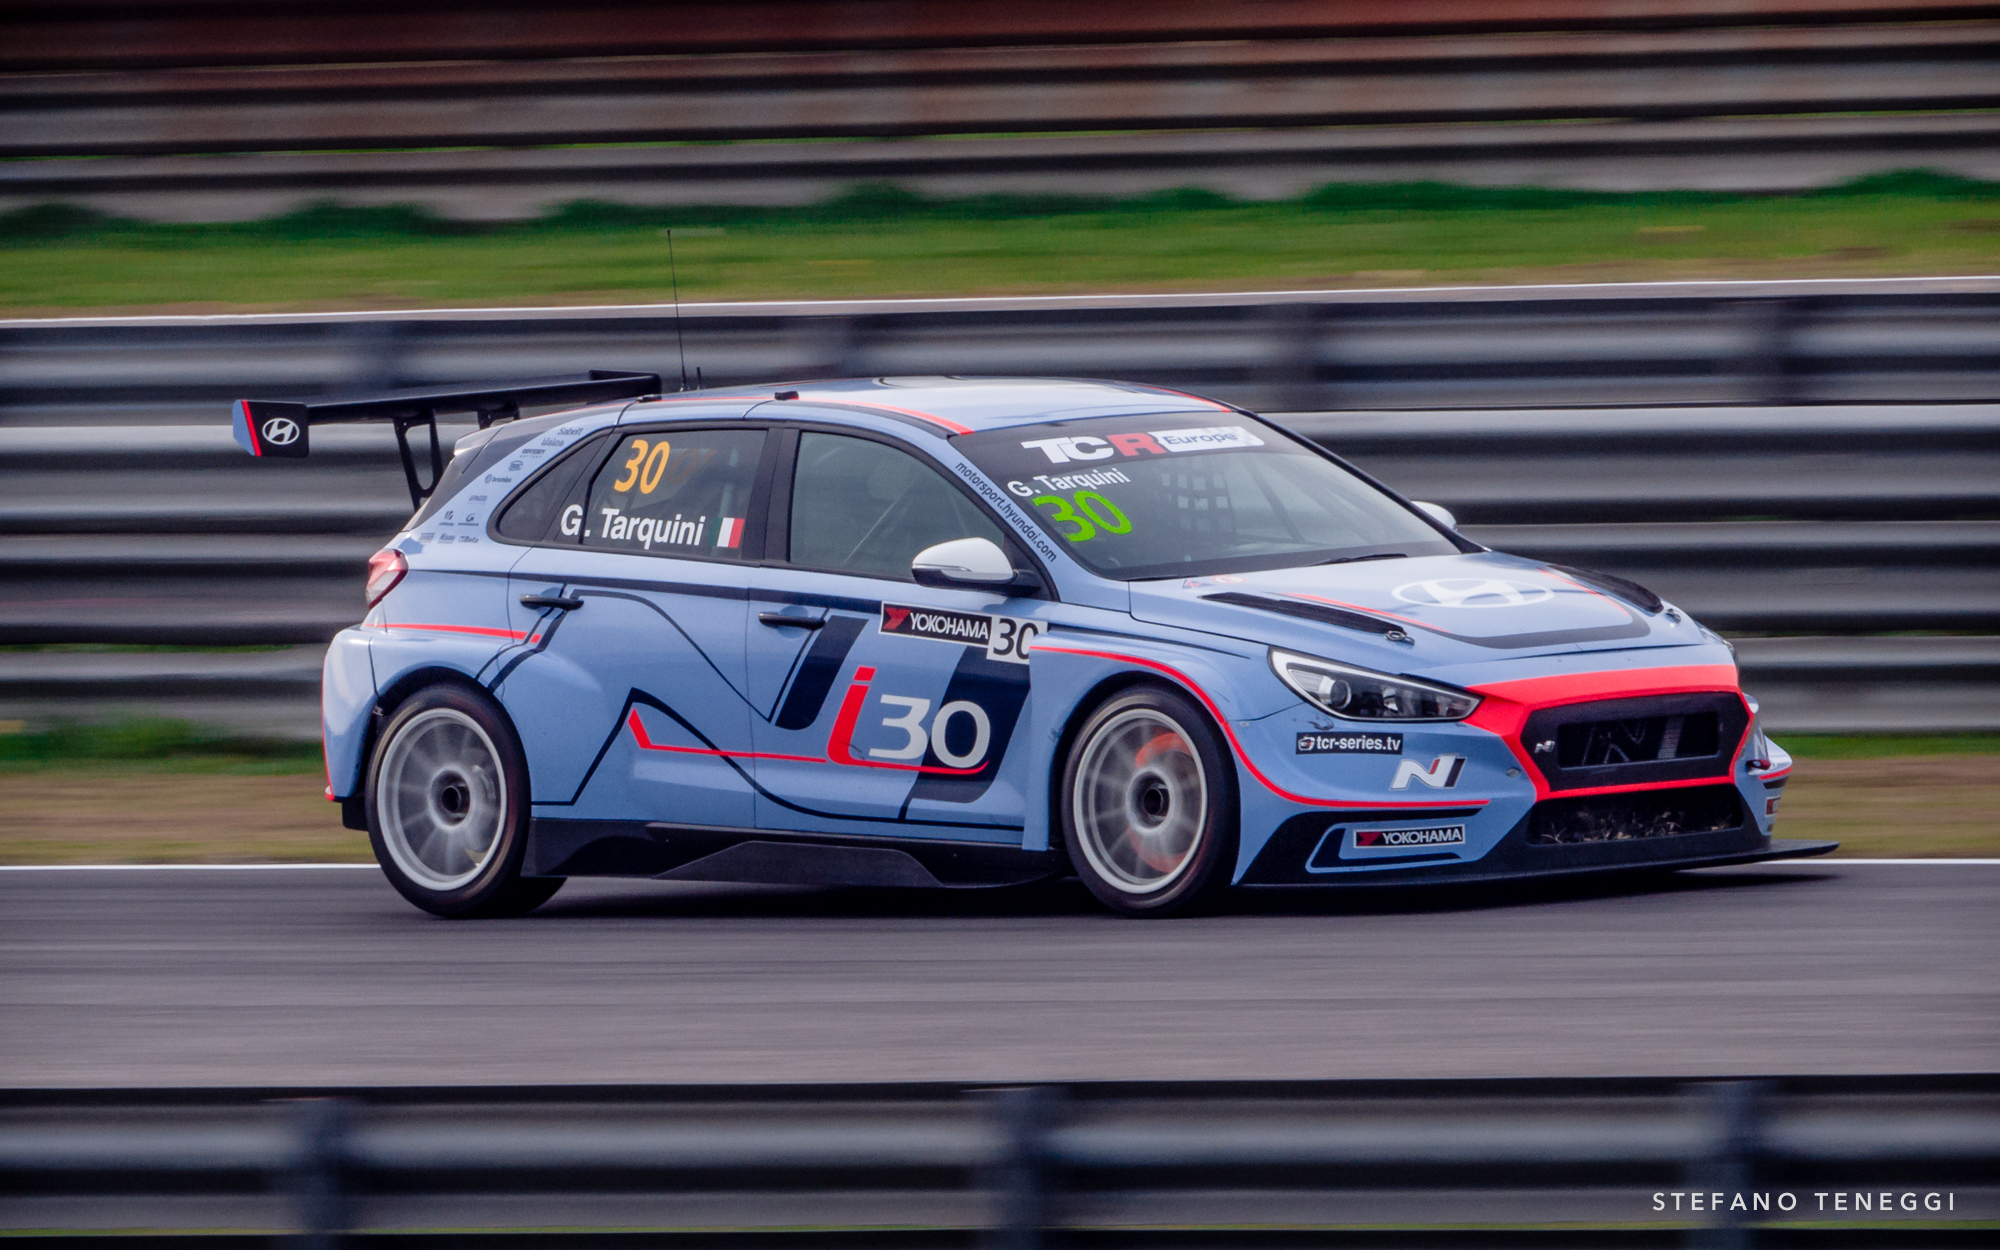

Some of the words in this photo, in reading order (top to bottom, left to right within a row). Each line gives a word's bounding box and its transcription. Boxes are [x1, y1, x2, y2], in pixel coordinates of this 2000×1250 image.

[613, 439, 671, 495] 30
[1020, 432, 1166, 464] TCR
[1163, 431, 1238, 446] Europe
[1007, 480, 1041, 498] G.
[1033, 467, 1132, 492] Tarquini
[560, 504, 591, 537] G.
[601, 507, 706, 550] Tarquini
[955, 460, 1057, 563] motorsport.hyundai.com
[1031, 489, 1133, 543] 30
[910, 612, 989, 640] YOKOHAMA
[992, 617, 1039, 660] 30
[827, 665, 991, 776] i30
[1317, 735, 1401, 751] tcr-series.tv
[1382, 827, 1462, 845] YOKOHAMA
